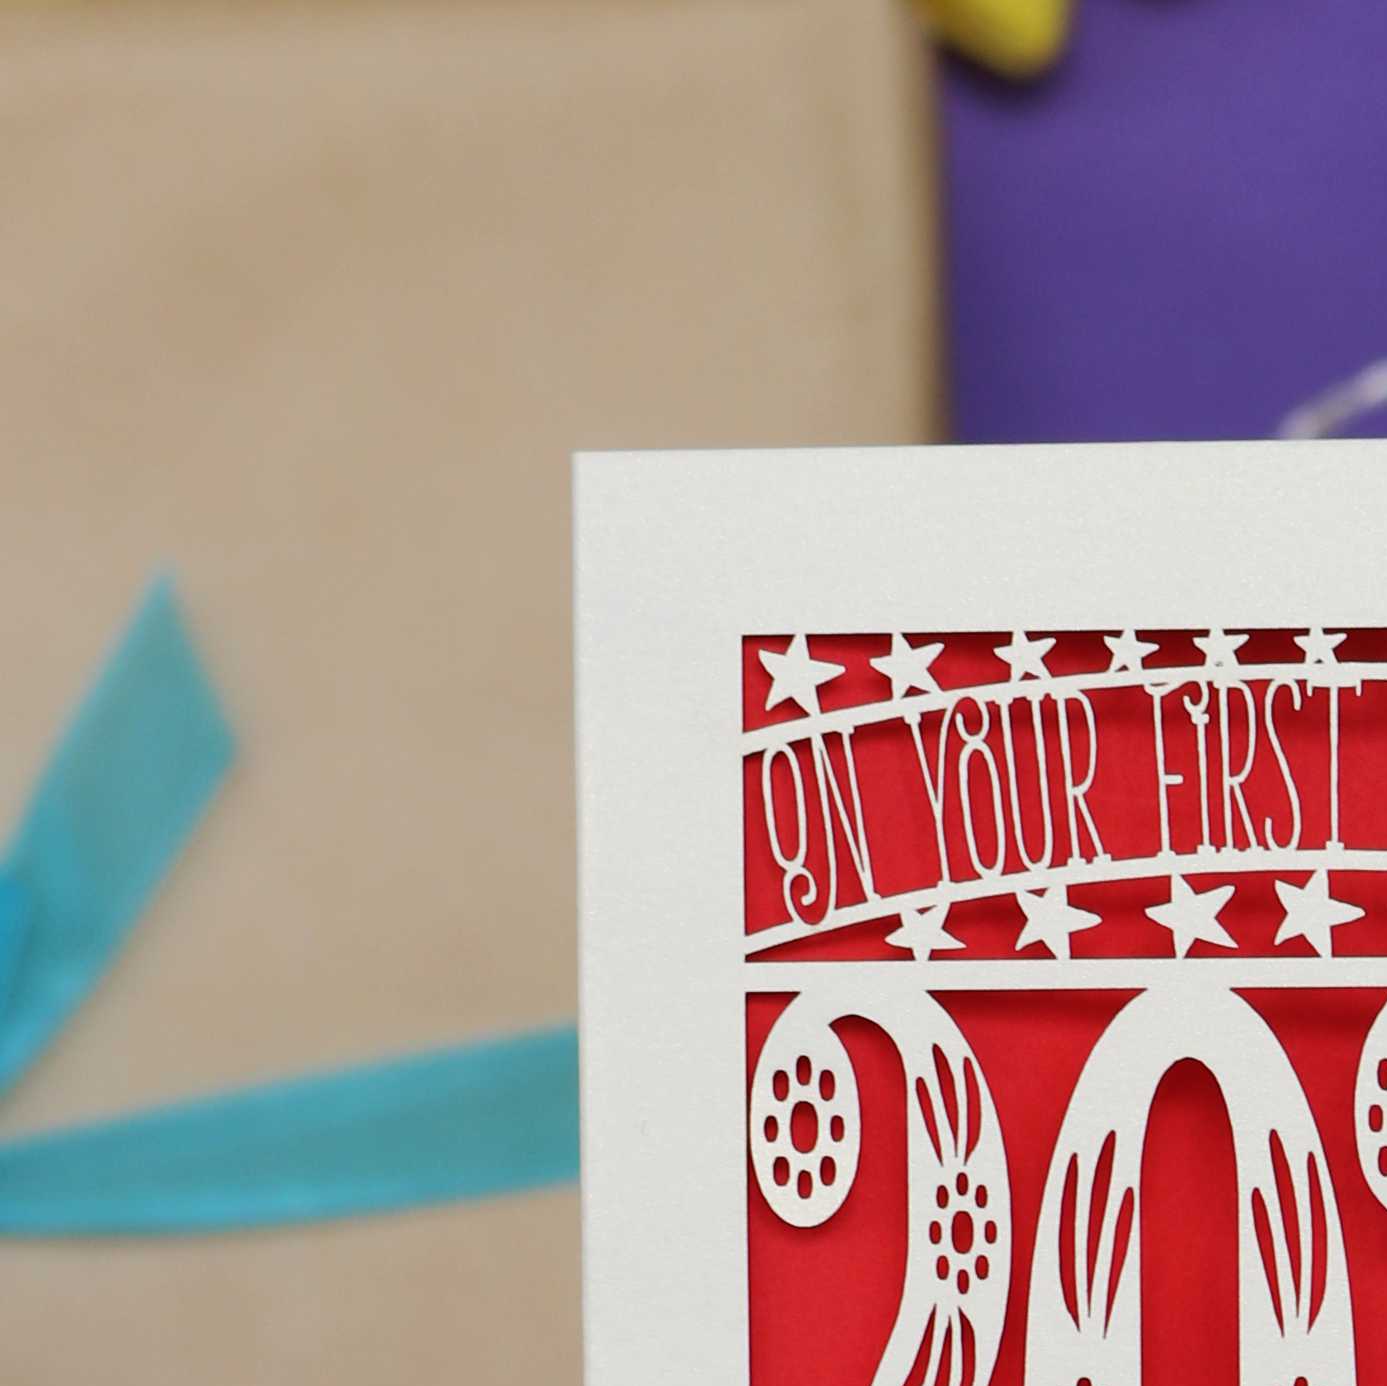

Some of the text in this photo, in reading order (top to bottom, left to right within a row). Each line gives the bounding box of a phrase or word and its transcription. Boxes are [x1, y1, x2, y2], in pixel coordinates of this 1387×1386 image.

[761, 728, 882, 926] ON
[901, 692, 1112, 888] YOUR
[1143, 678, 1363, 858] FIRST
